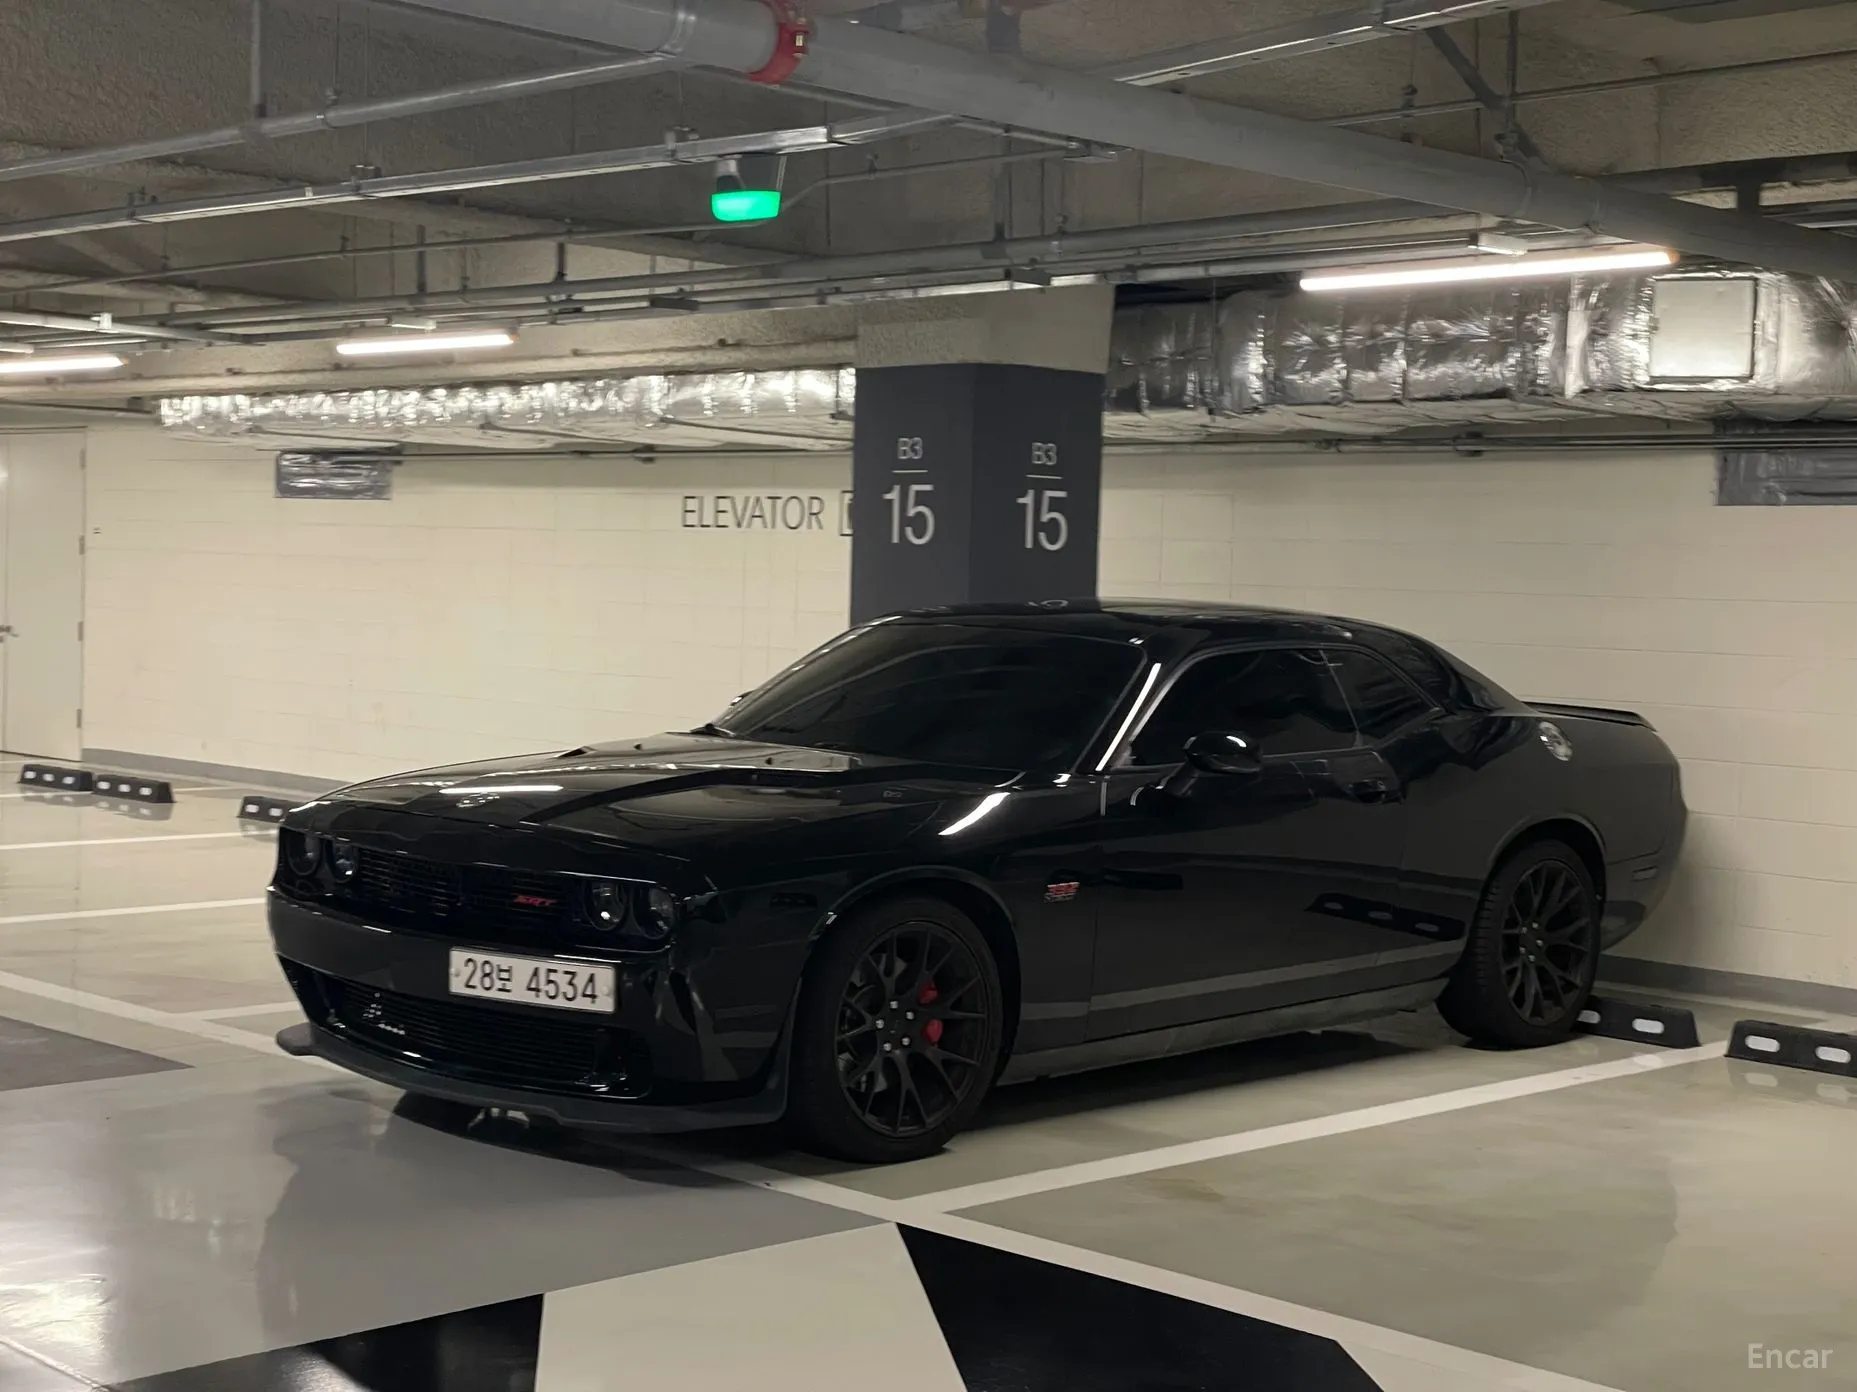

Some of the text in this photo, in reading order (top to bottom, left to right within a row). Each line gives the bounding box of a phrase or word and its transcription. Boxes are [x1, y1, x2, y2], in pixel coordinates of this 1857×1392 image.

[898, 437, 923, 460] B3
[1032, 442, 1057, 465] B3
[681, 494, 824, 530] ELEVATOR
[882, 484, 936, 545] 15
[1016, 489, 1068, 551] 15
[463, 957, 598, 1004] 28보 4534
